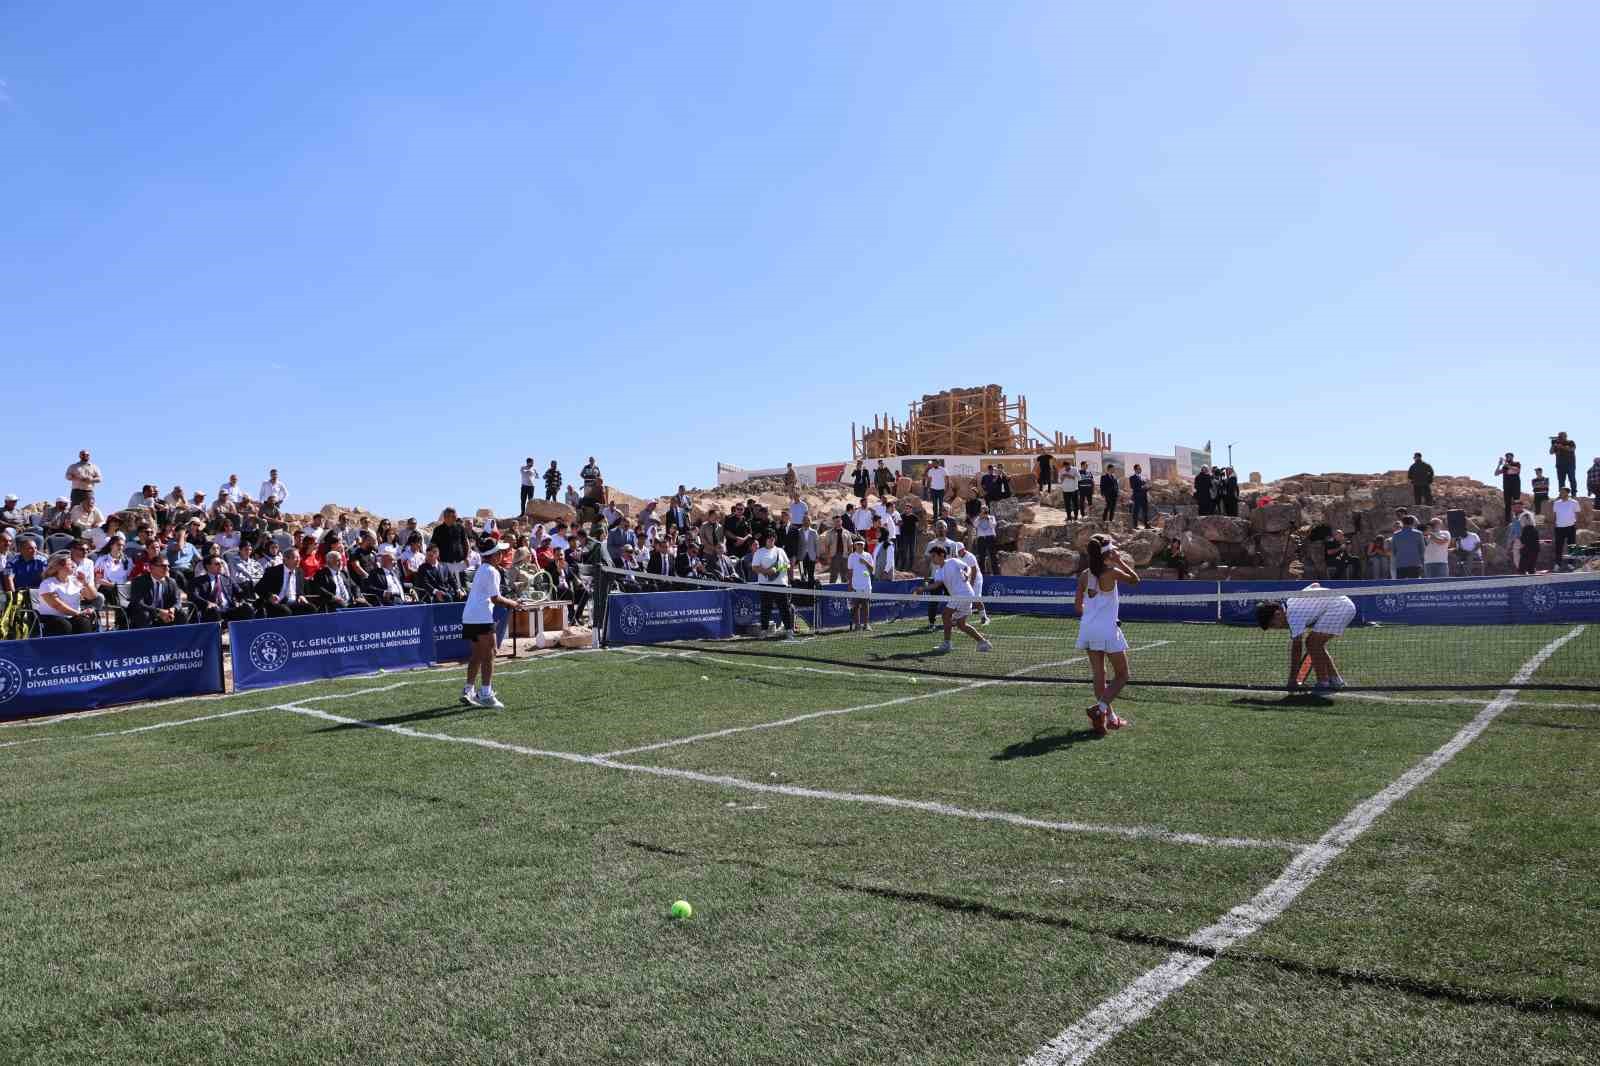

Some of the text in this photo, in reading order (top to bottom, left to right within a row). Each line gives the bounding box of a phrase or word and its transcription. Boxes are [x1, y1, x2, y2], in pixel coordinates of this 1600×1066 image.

[449, 623, 463, 632] SPO
[291, 640, 307, 648] T.C.
[309, 634, 346, 647] GENÇLİK
[347, 633, 359, 642] VE
[361, 630, 381, 641] SPOR
[26, 648, 204, 677] T.C. GENÇLİK VE SPOR BAKANLIĞI
[116, 670, 127, 679] VE
